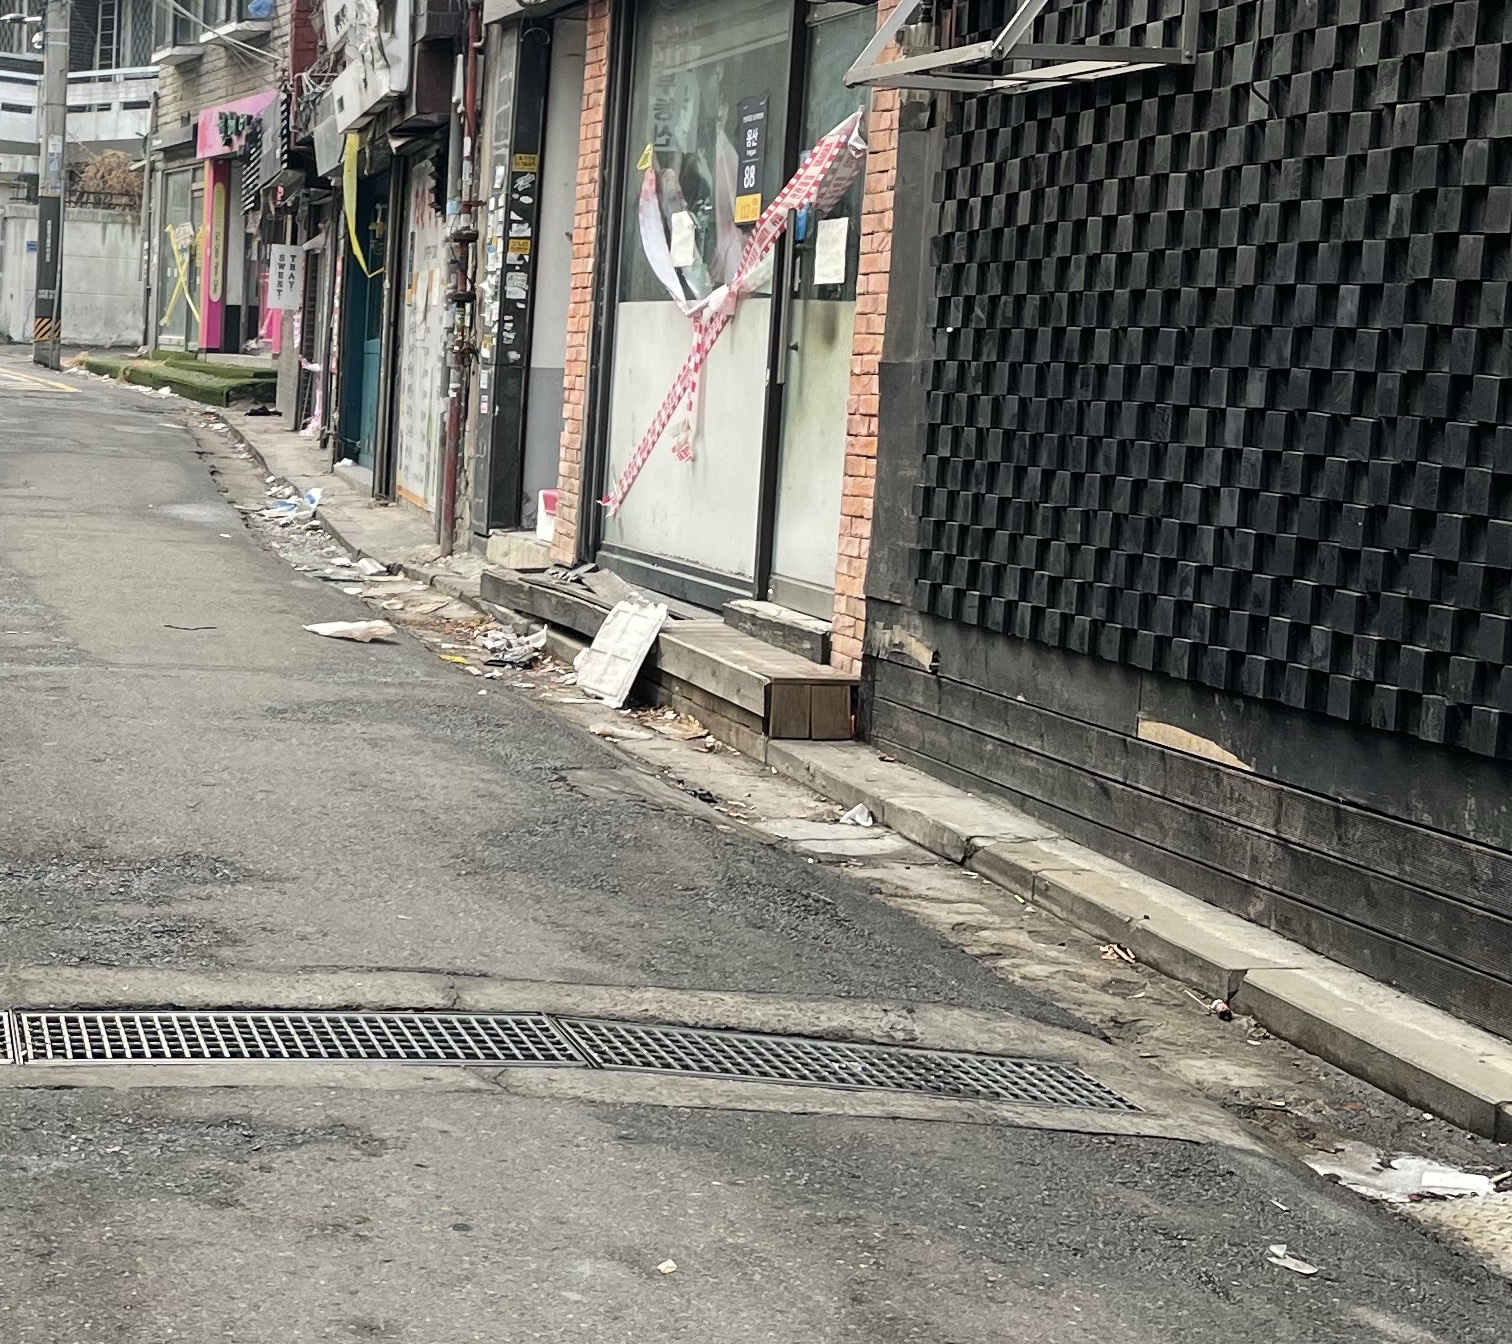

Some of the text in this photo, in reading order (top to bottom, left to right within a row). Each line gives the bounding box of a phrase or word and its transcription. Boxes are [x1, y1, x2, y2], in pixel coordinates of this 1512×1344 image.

[746, 127, 759, 148] 용산
[743, 164, 756, 189] 88
[277, 254, 297, 297] SWEET TRAY
